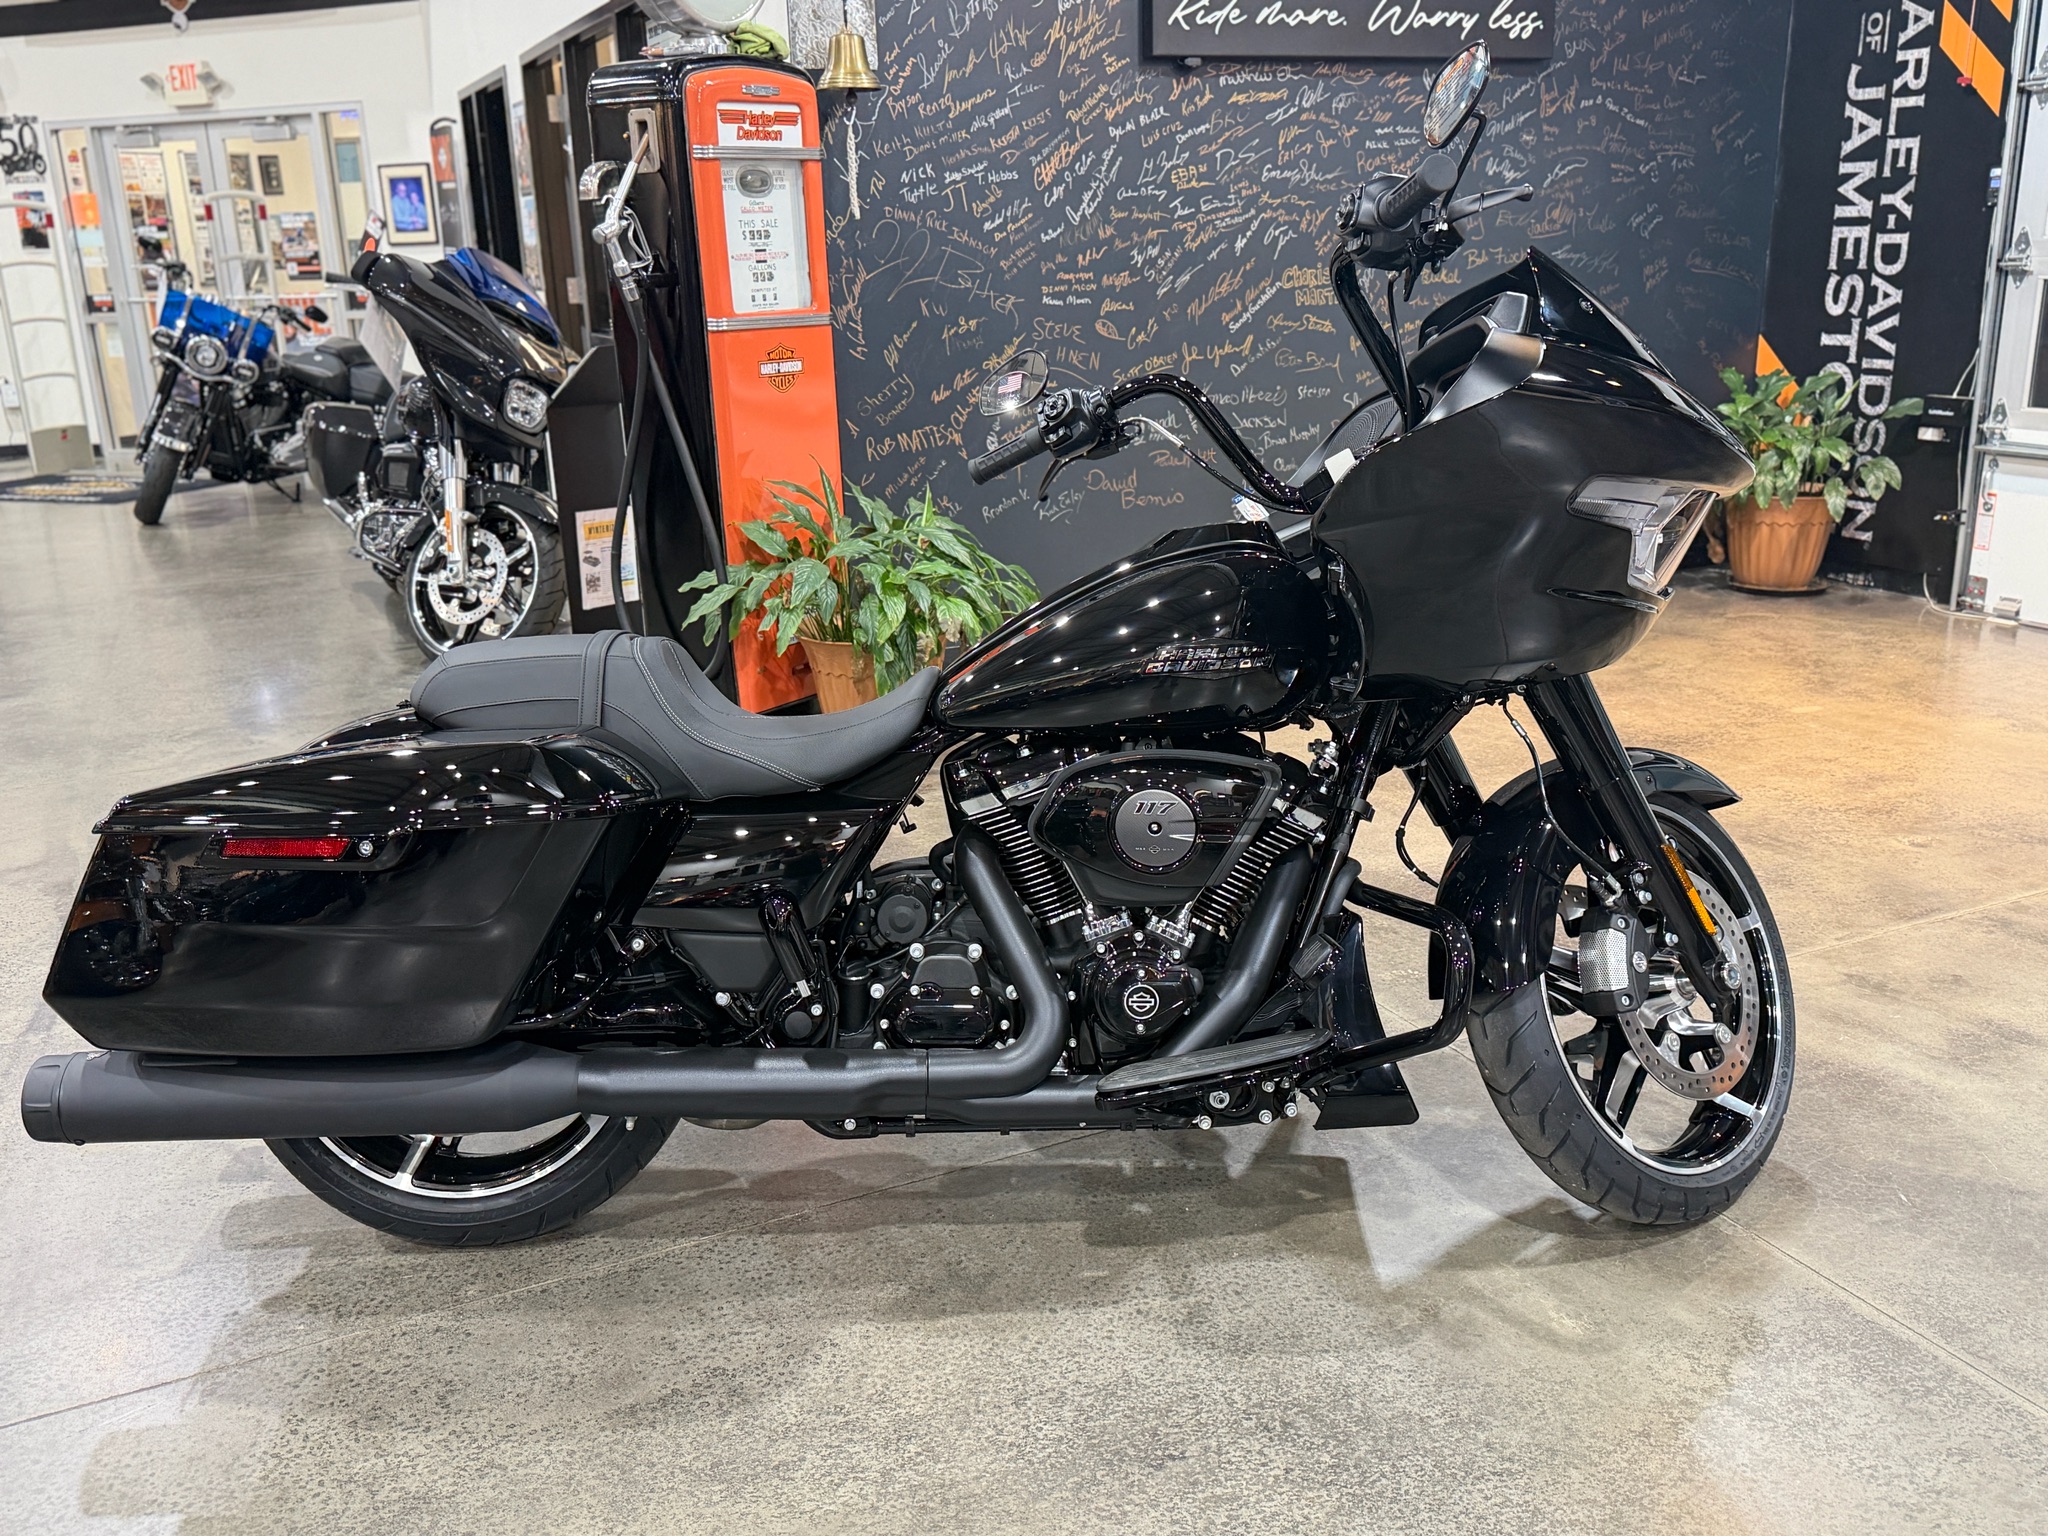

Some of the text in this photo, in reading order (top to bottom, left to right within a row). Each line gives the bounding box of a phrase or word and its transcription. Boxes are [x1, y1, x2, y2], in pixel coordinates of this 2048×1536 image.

[1255, 1, 1347, 26] more.
[1368, 0, 1480, 40] Worry
[1489, 0, 1544, 39] less.
[1866, 12, 1884, 53] OF
[169, 64, 197, 92] EXIT
[1219, 69, 1273, 87] Matthew
[886, 92, 921, 120] Bryson
[745, 110, 776, 128] Harley
[737, 126, 783, 141] Davidson
[872, 134, 911, 158] Keith
[900, 182, 939, 204] Tuttle
[739, 219, 778, 229] THIS SALE
[748, 263, 777, 272] GALLONS
[1032, 317, 1086, 344] STEVE
[769, 349, 794, 360] MOTOR
[1112, 364, 1143, 385] SCOTT
[1133, 800, 1179, 815] 117
